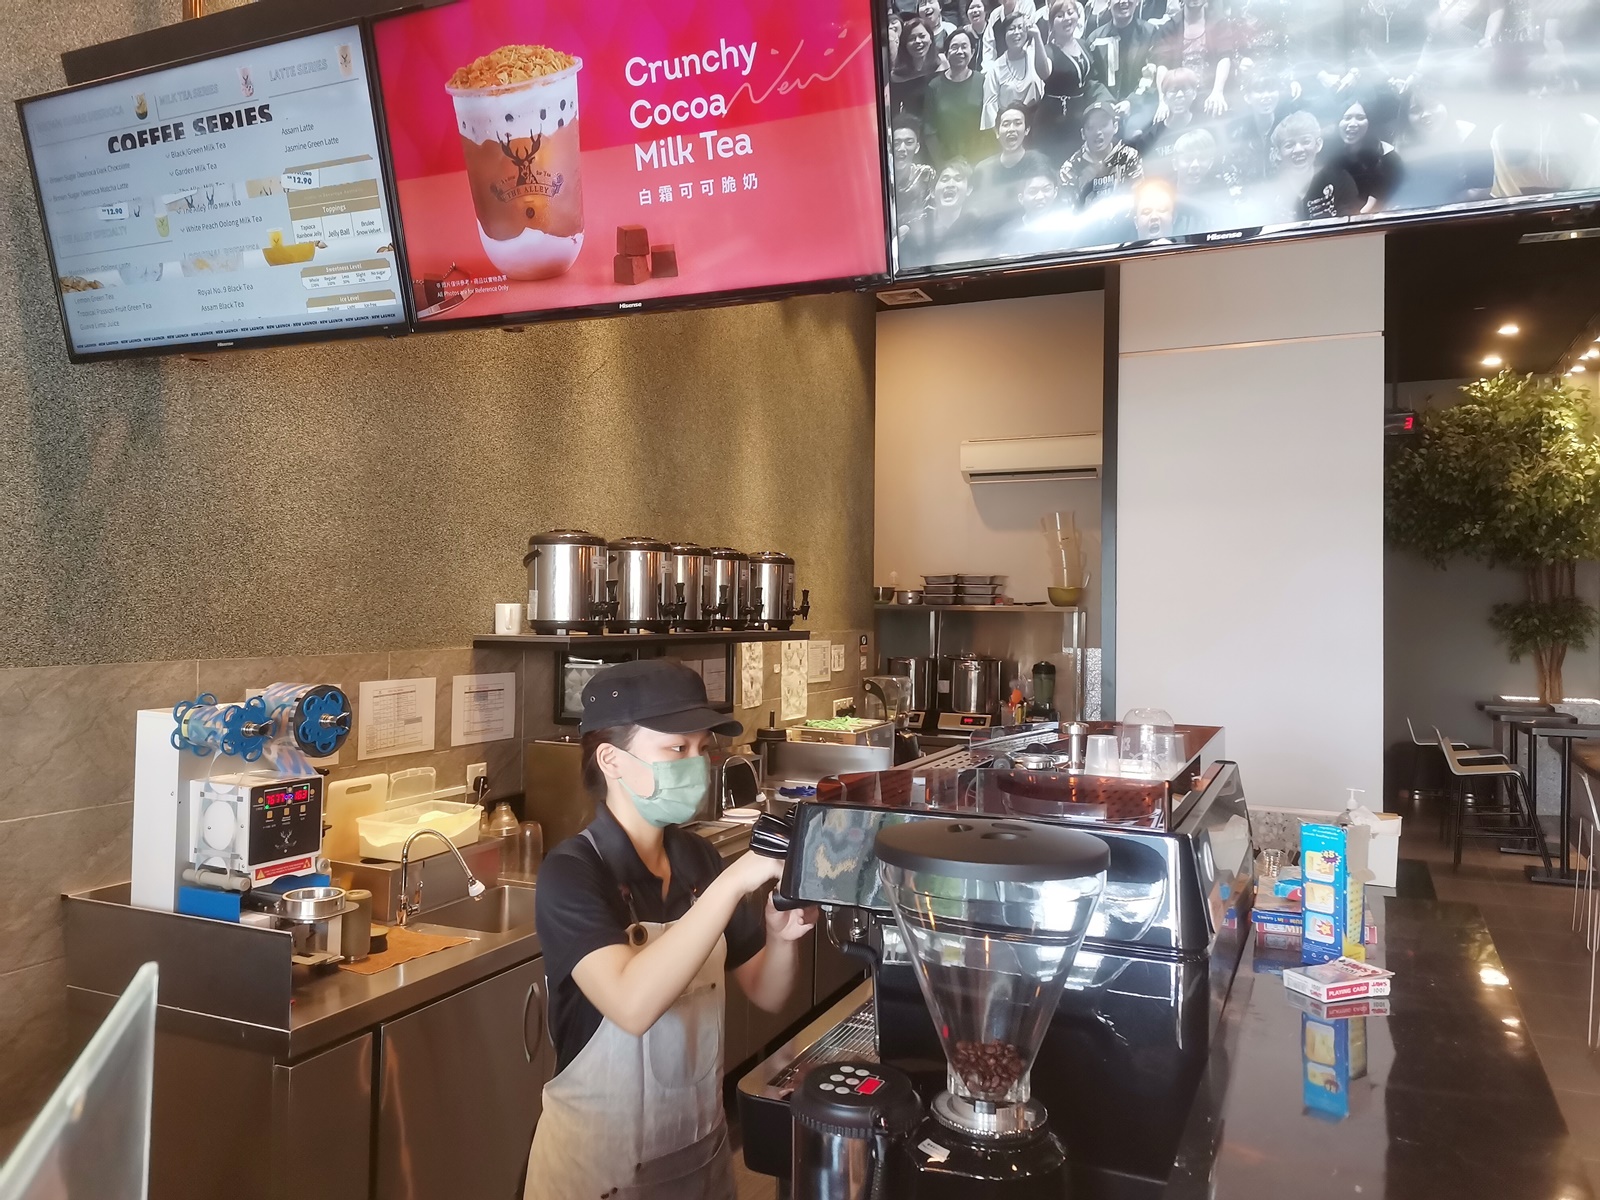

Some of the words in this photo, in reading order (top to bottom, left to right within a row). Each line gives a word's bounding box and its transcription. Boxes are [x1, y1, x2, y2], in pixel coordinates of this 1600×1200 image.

[625, 38, 757, 87] Crunchy
[629, 93, 727, 129] Cocoa
[107, 122, 186, 154] COFFEE
[193, 104, 273, 136] SERIES
[281, 125, 299, 136] Assam
[299, 123, 315, 133] Latte
[216, 142, 227, 150] Tea
[284, 143, 307, 153] Jasmine
[307, 140, 324, 149] Green
[324, 136, 339, 145] Latte
[634, 134, 695, 172] Milk
[699, 130, 753, 161] Tea
[174, 166, 195, 177] Garden
[194, 165, 206, 173] Milk
[206, 162, 218, 171] Tea
[292, 175, 313, 185] 12.90
[507, 189, 522, 199] THE
[524, 185, 549, 194] ALLEY
[638, 173, 759, 206] 白霜可可脆奶
[106, 207, 123, 216] 12.90
[322, 204, 346, 214] Toppings
[185, 225, 202, 233] White
[201, 222, 219, 231] Peach
[218, 219, 240, 229] Oolong
[252, 215, 263, 223] Tea
[328, 230, 340, 238] Jelly
[340, 228, 351, 237] Ball
[1206, 232, 1242, 241] Hisense
[326, 265, 349, 273] Sweetness
[197, 288, 213, 297] Royal
[227, 284, 242, 293] Black
[242, 283, 254, 291] Tea
[498, 284, 509, 292] Only
[201, 303, 218, 312] Assam
[234, 300, 245, 308] Tea
[619, 301, 642, 310] Hisense
[1328, 988, 1351, 997] PLAYING
[1352, 985, 1368, 993] CARD
